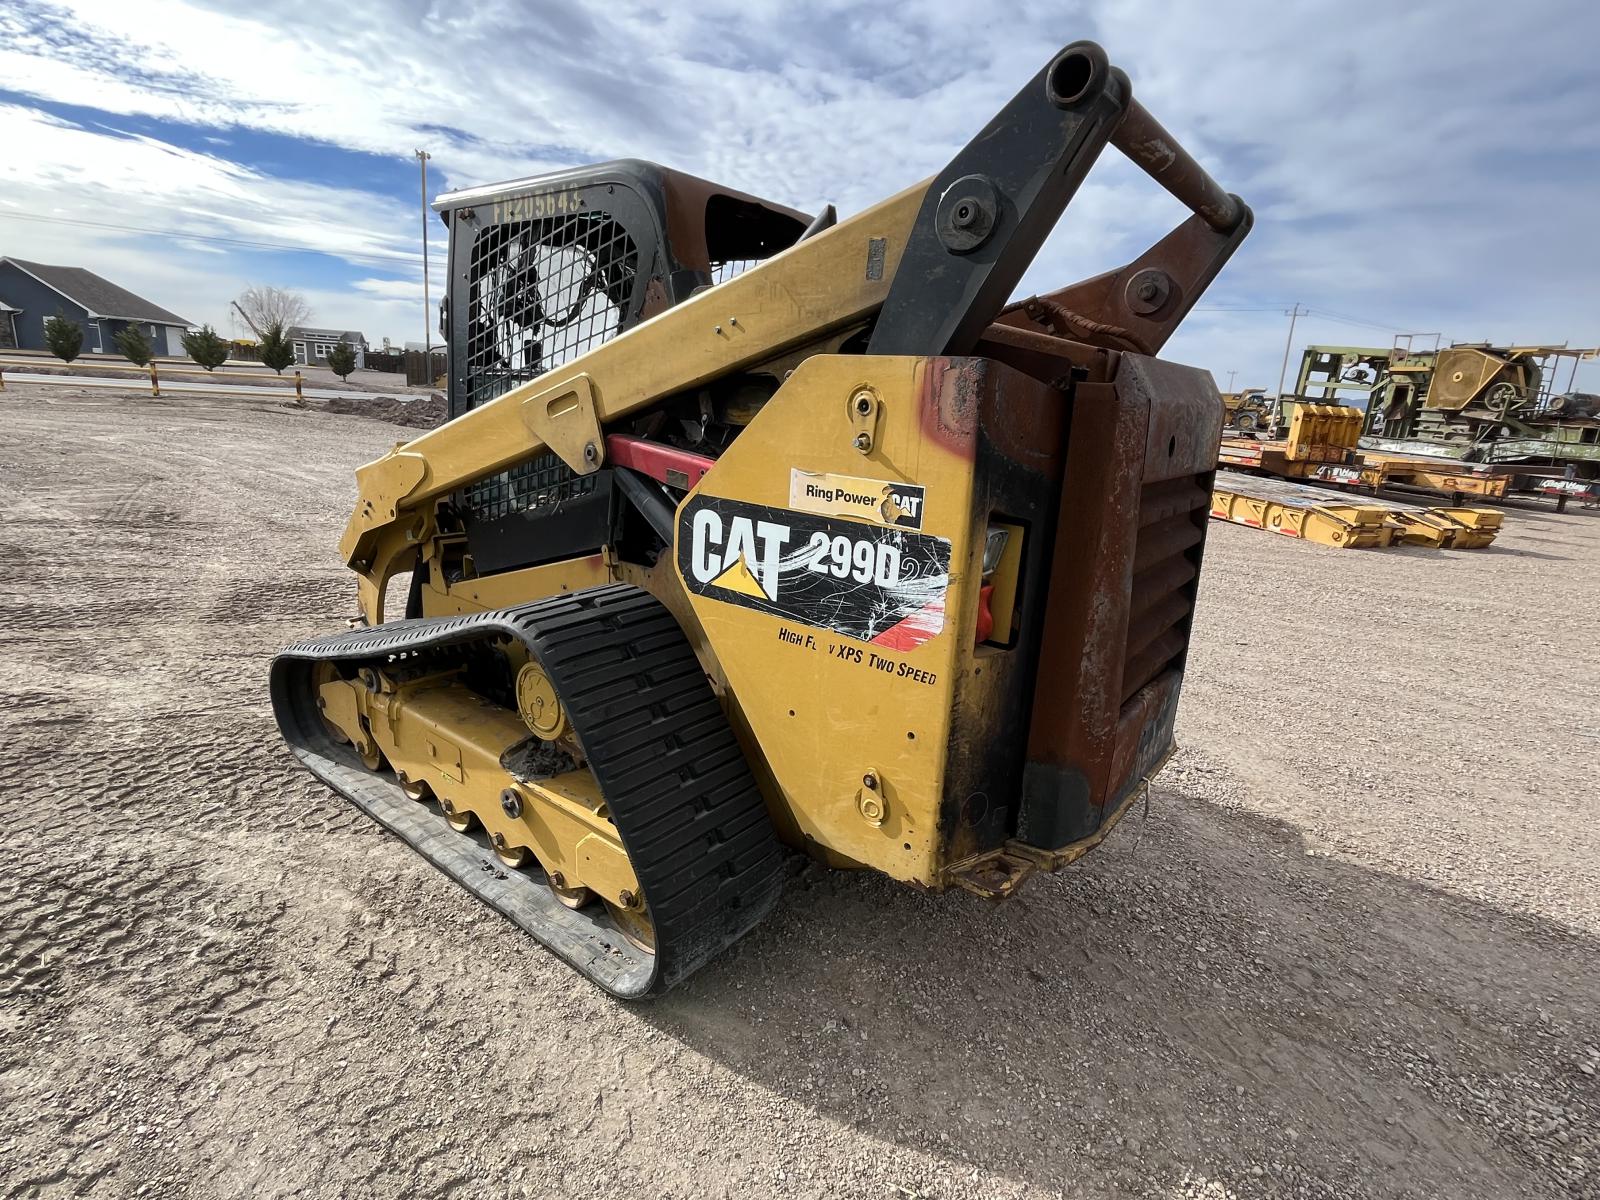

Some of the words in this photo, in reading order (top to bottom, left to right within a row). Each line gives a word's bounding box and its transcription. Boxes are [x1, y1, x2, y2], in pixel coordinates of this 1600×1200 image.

[806, 484, 834, 502] Ring
[835, 489, 877, 507] Power
[691, 508, 791, 603] CAT
[778, 627, 803, 647] HIGH
[837, 644, 864, 664] XPS
[868, 653, 895, 673] TWO
[897, 662, 937, 686] SPEED
